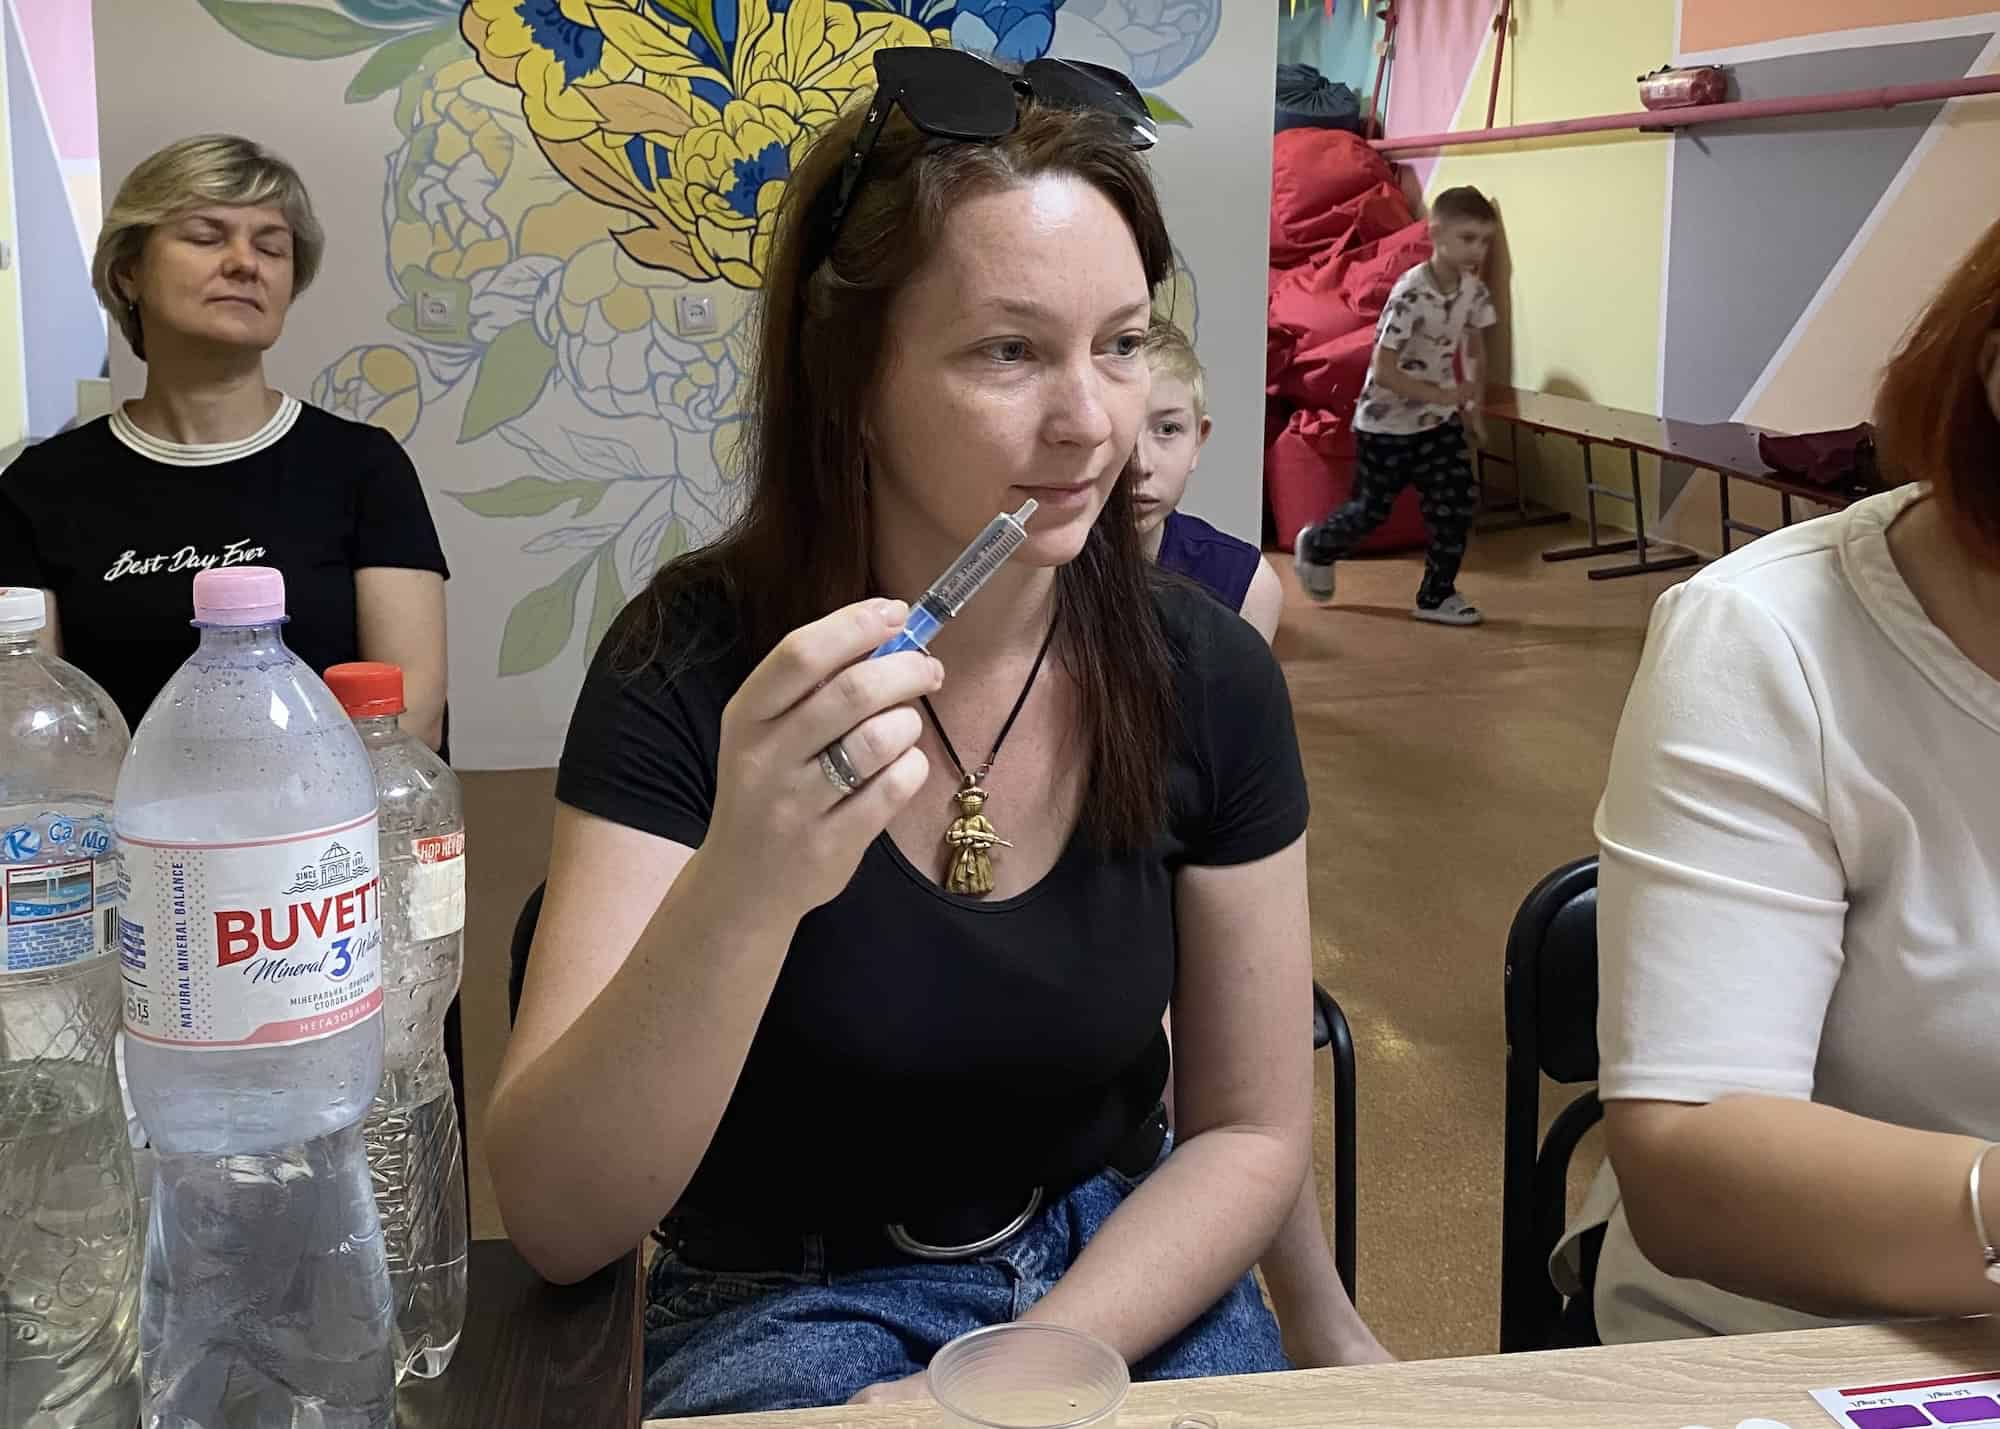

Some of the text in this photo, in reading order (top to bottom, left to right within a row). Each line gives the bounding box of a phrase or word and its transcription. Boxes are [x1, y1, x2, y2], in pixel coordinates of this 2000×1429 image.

[104, 538, 266, 581] Best Day Ever
[7, 830, 40, 857] K
[81, 831, 108, 853] Mg
[295, 869, 317, 882] SINCE
[172, 863, 193, 1028] NATURAL MINERAL BALANCE
[243, 952, 329, 984] Mineral
[330, 937, 352, 977] 3
